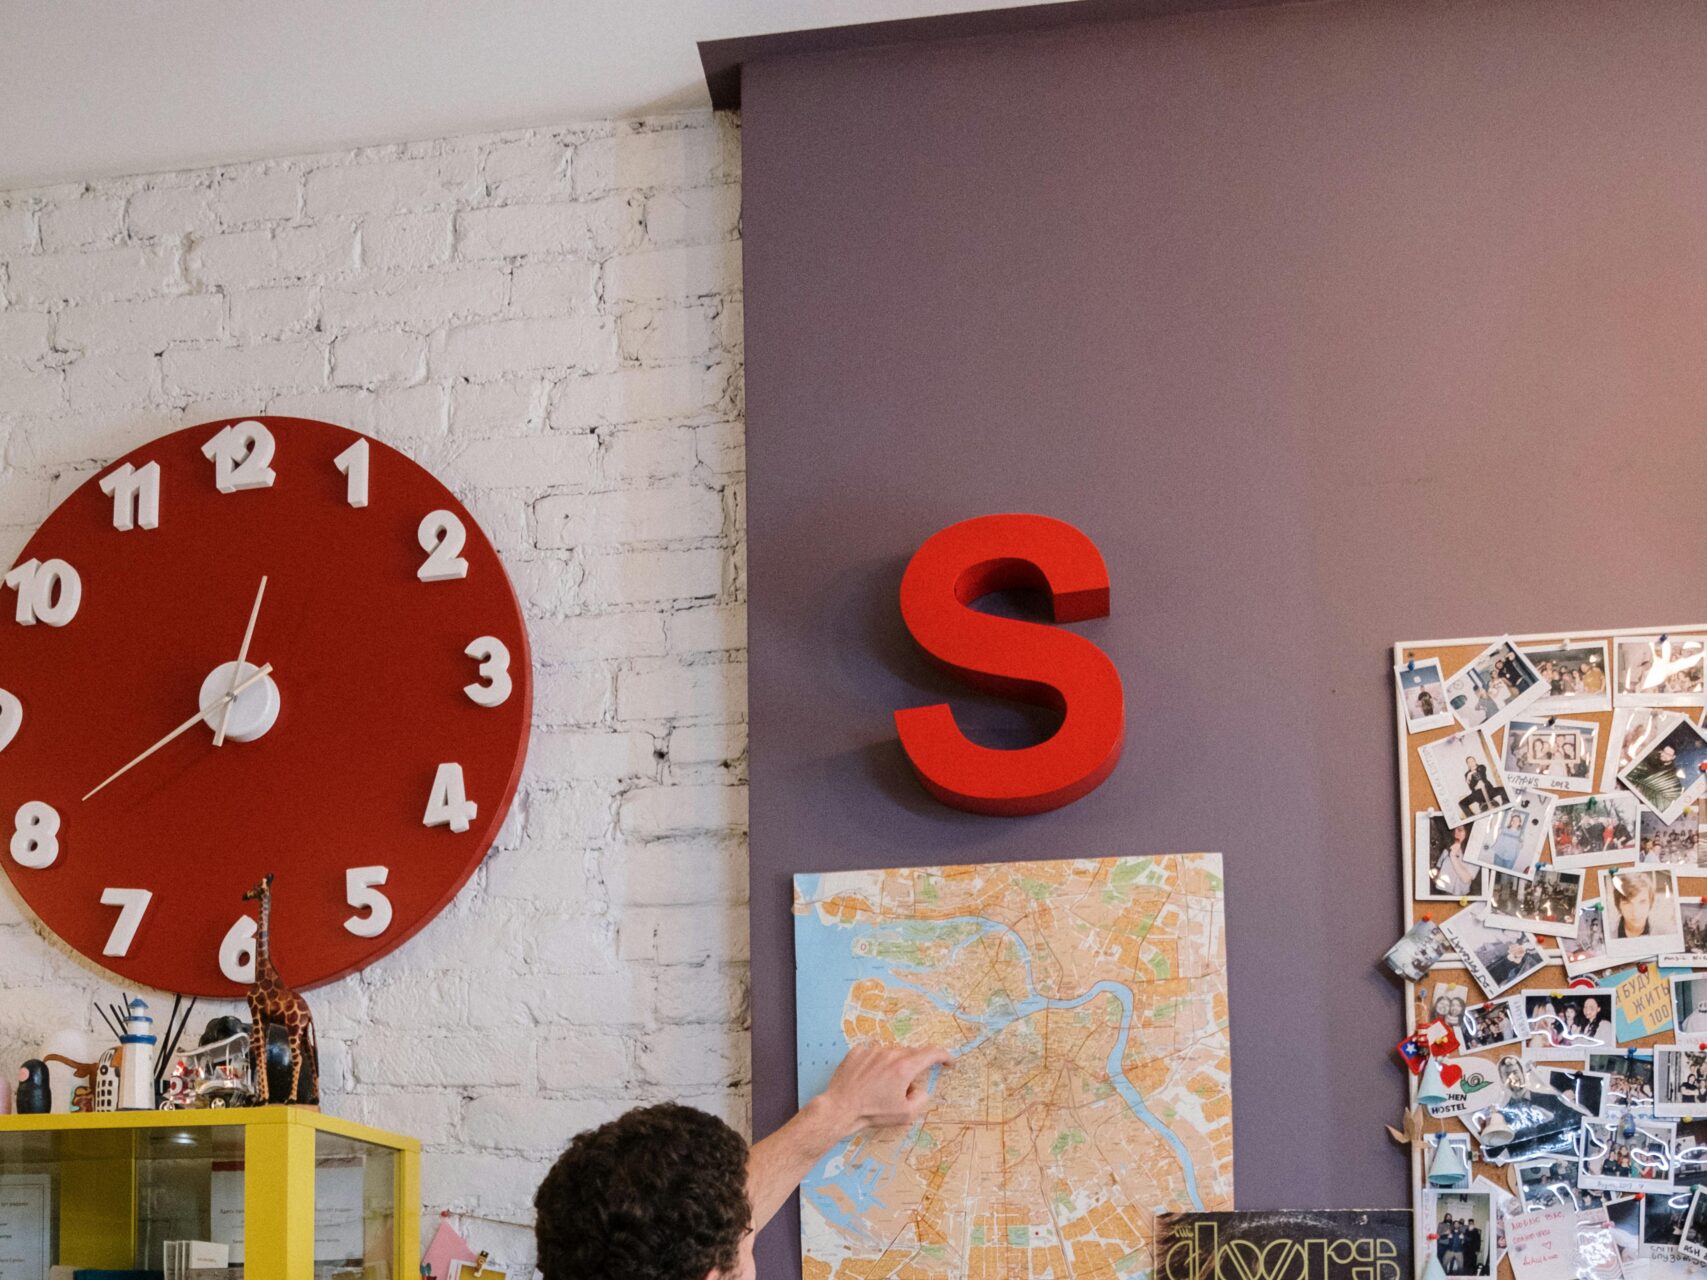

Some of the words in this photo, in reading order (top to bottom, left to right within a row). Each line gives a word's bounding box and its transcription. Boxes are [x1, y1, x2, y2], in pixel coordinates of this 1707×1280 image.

[201, 420, 276, 494] 12
[333, 437, 369, 508] 1
[99, 460, 160, 532] 11
[417, 509, 469, 582] 2
[4, 557, 82, 628] 10
[463, 635, 512, 707] 3
[894, 513, 1126, 817] S
[423, 762, 477, 833] 4
[10, 800, 61, 869] 8
[100, 887, 153, 957] 7
[343, 865, 392, 938] 5
[219, 914, 257, 984] 6
[1622, 971, 1650, 999] БУДУ
[1633, 984, 1669, 1015] ЖИТЬ
[1649, 1004, 1669, 1026] 100
[1432, 1103, 1466, 1114] HOSTEL
